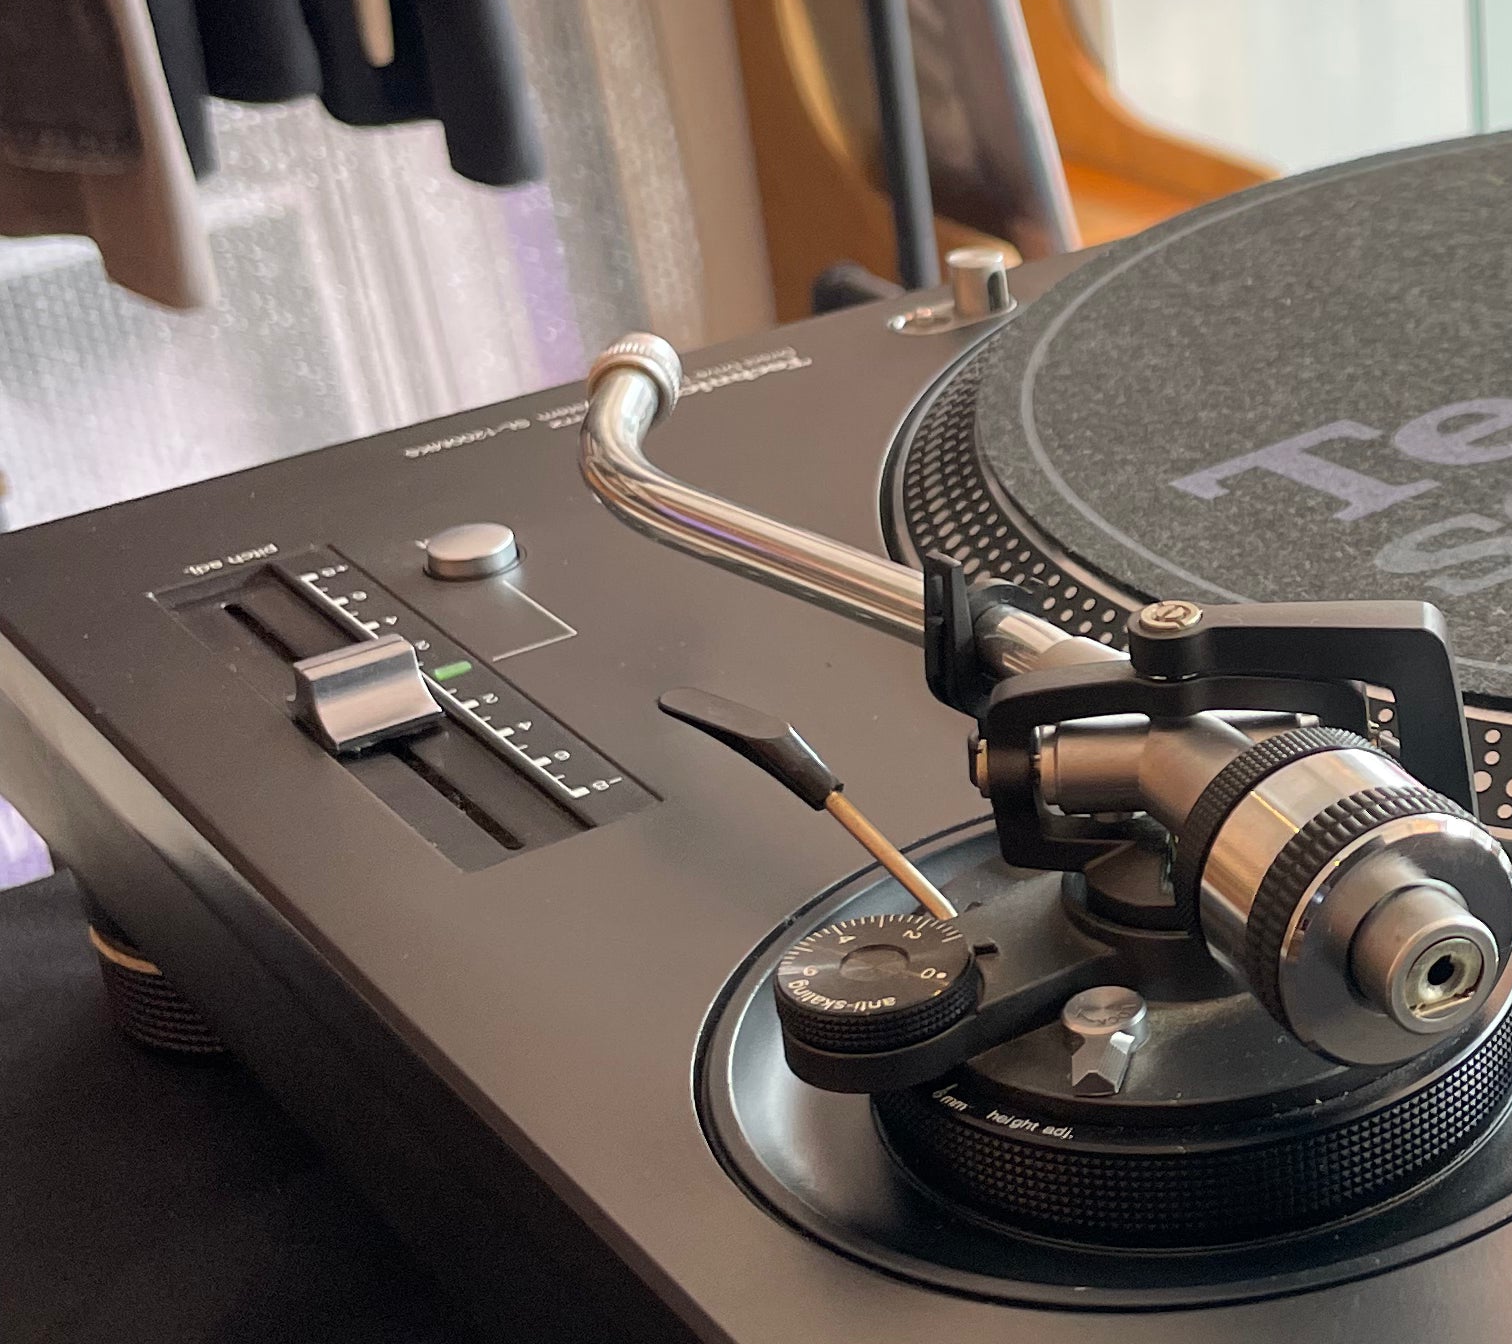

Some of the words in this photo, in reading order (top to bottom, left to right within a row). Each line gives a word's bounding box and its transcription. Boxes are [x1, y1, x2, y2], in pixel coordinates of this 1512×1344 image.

[838, 934, 857, 945] 4
[901, 928, 922, 941] 2
[788, 978, 897, 1013] anti-skating
[985, 1108, 1041, 1134] height
